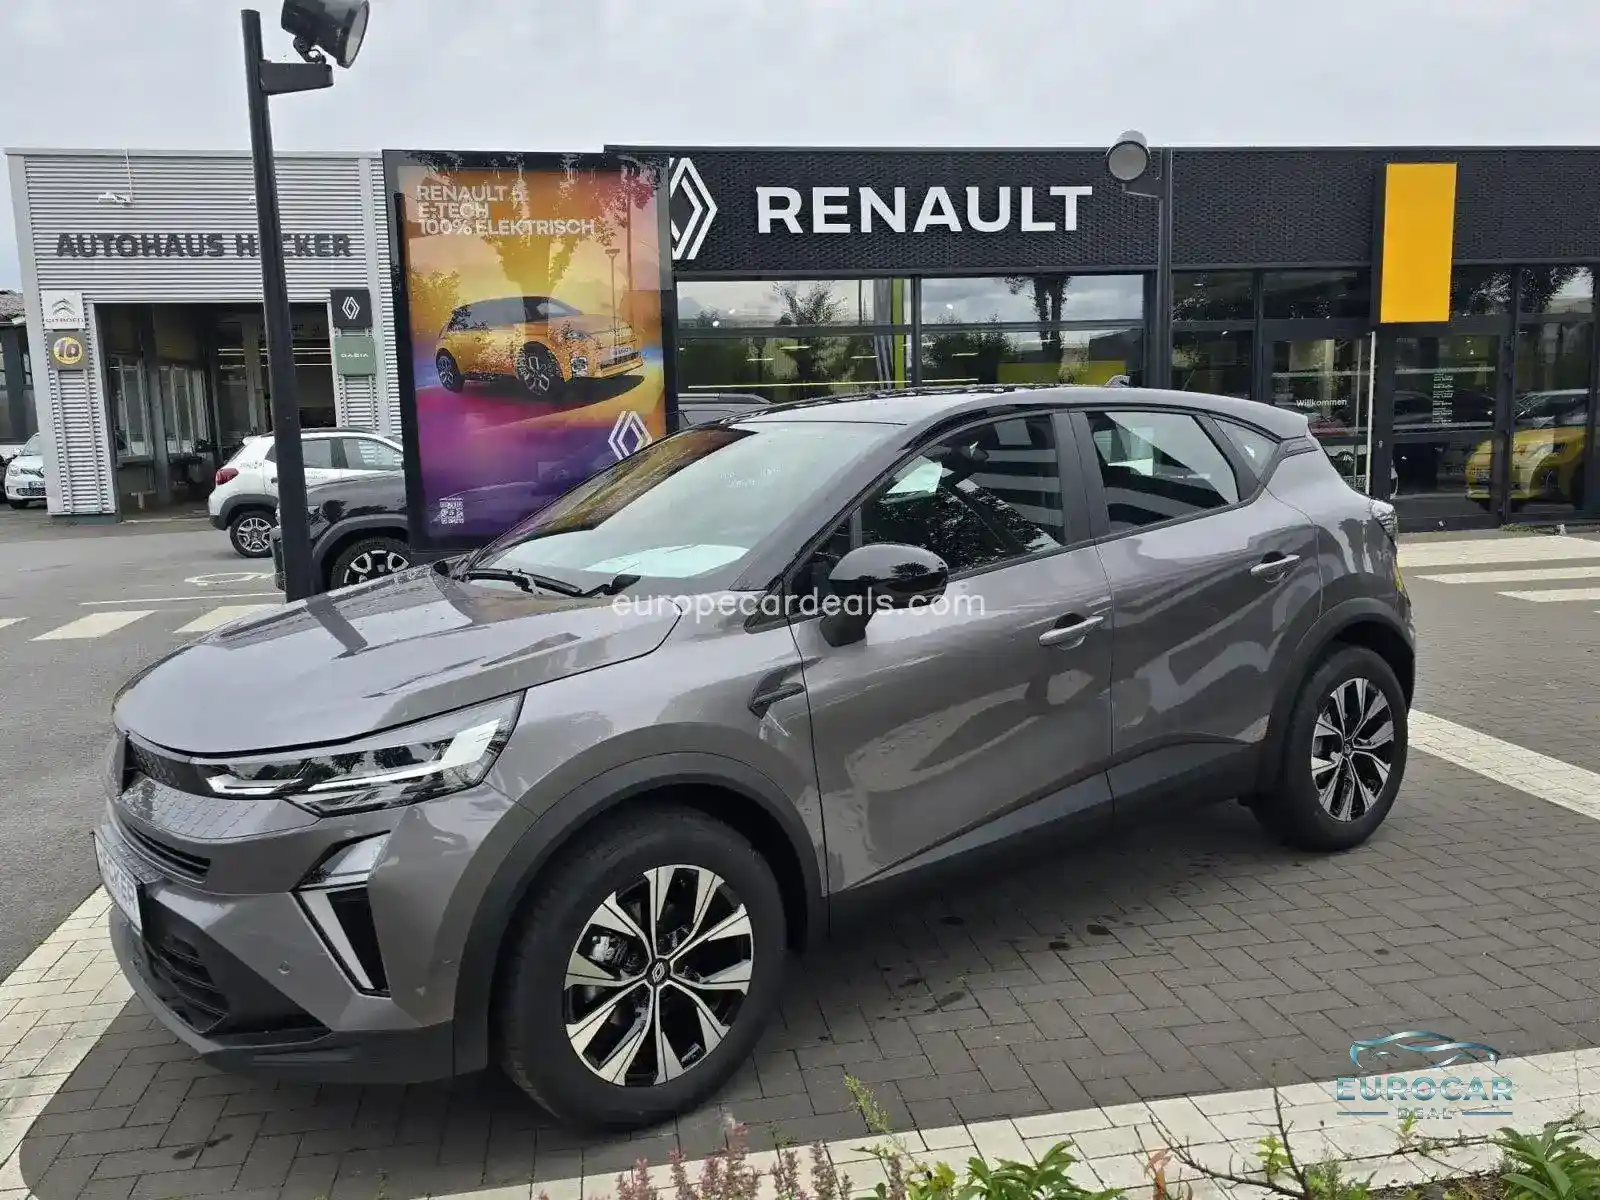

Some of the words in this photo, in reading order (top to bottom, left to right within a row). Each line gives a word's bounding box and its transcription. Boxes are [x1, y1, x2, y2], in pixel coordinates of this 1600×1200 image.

[417, 185, 508, 201] RENAULT
[418, 202, 489, 218] E-TECH
[755, 185, 1093, 234] RENAULT
[418, 218, 472, 235] 100%
[476, 218, 595, 235] ELEKTRISCH
[56, 232, 225, 257] AUTOHAUS
[236, 232, 351, 257] HCKER
[1295, 398, 1348, 408] Willkommen
